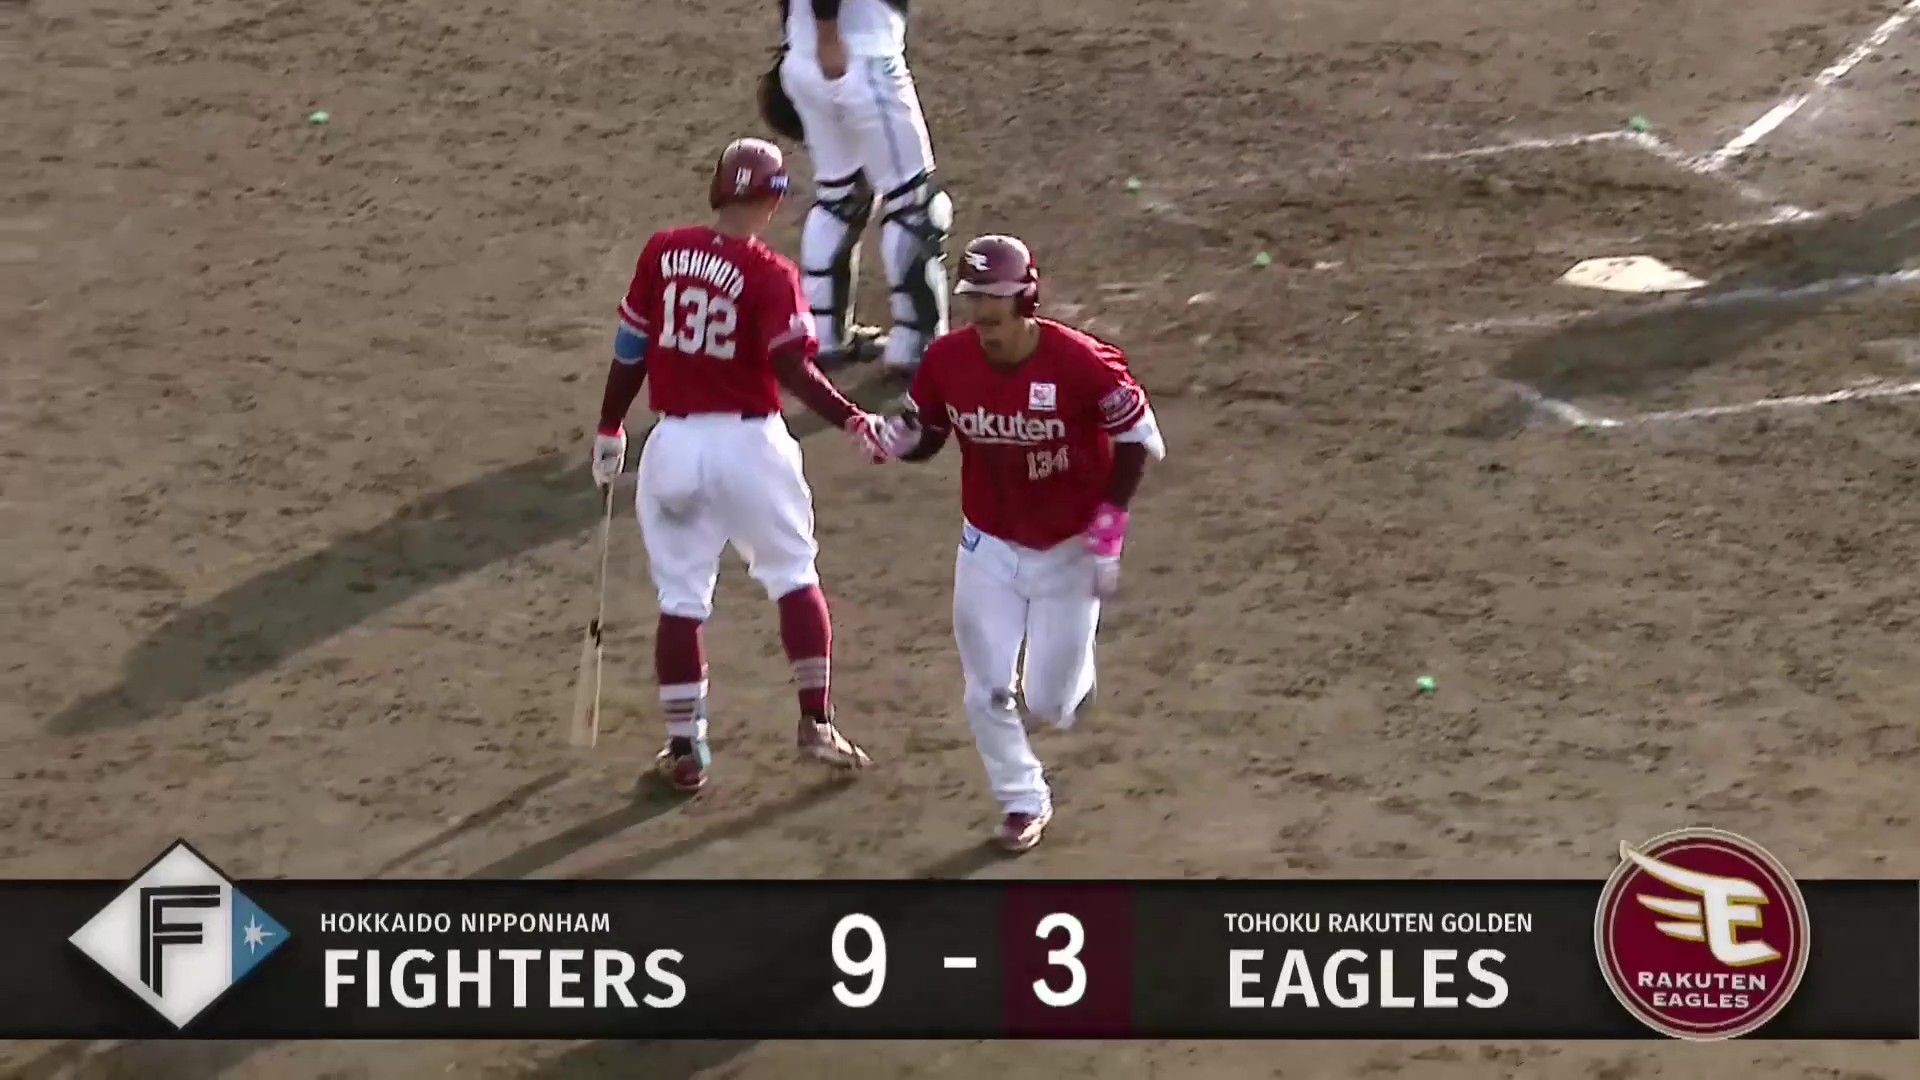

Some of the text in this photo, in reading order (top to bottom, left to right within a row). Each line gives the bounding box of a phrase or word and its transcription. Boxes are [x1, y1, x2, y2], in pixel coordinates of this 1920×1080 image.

[661, 250, 744, 300] KISHIMOTO
[658, 281, 738, 360] 132
[1026, 445, 1069, 480] 134
